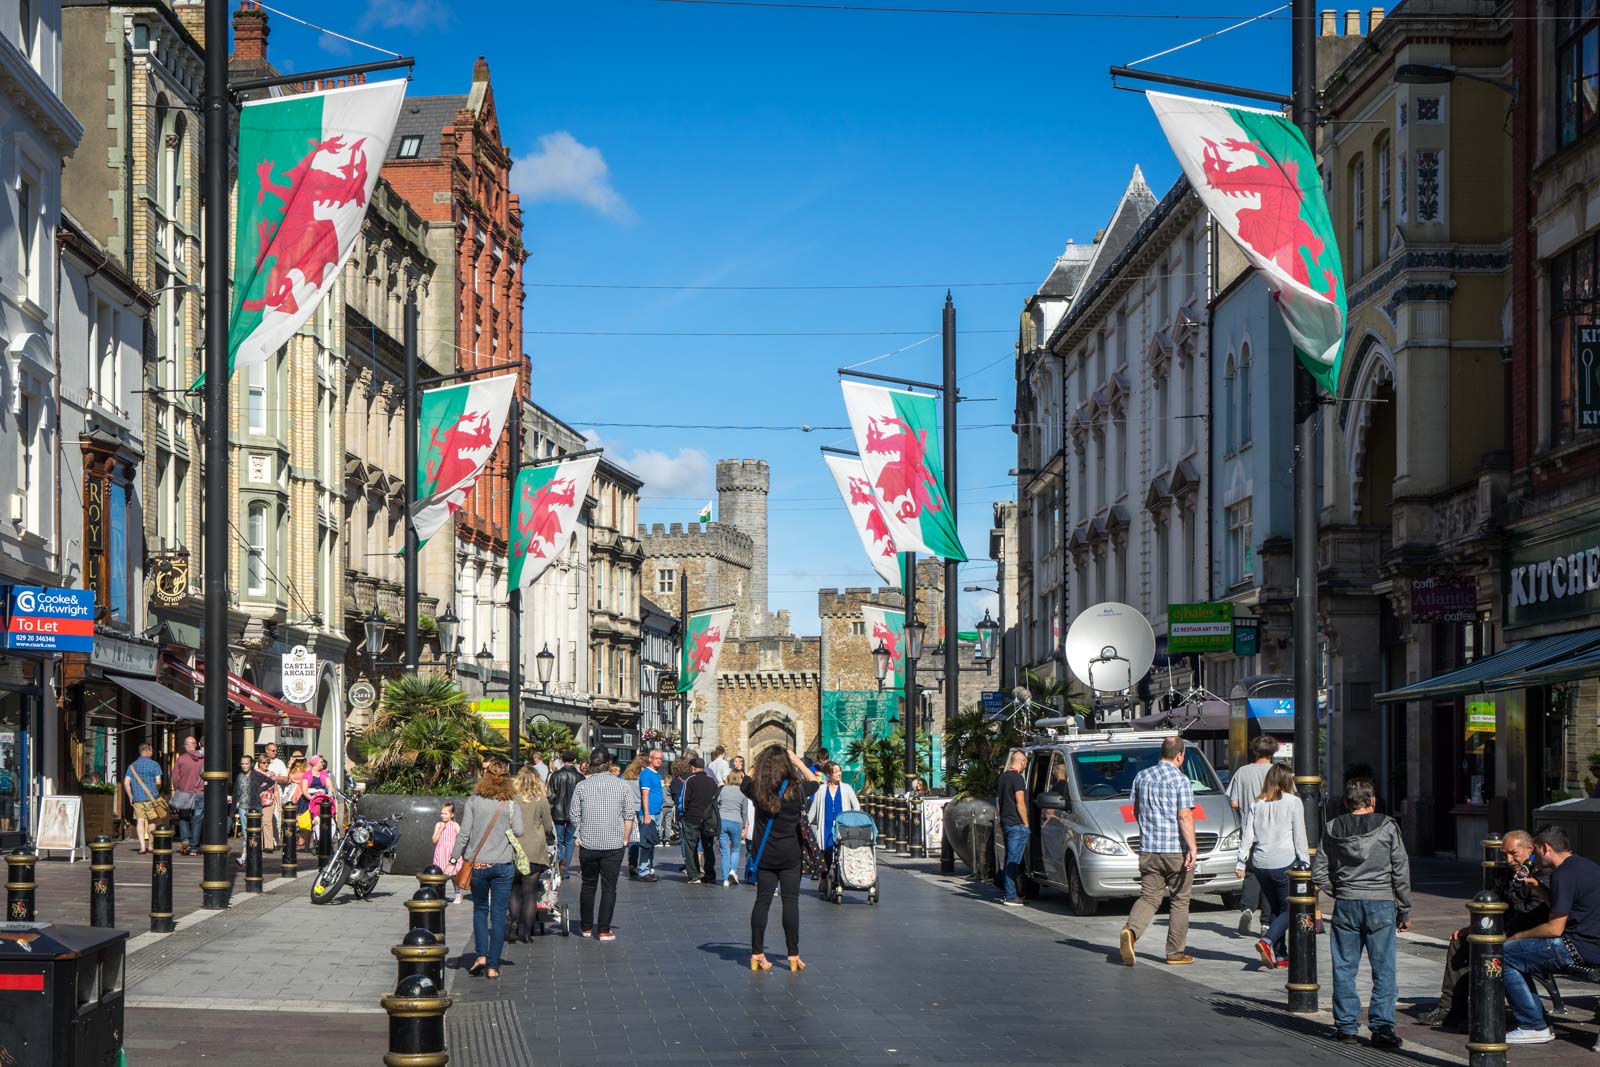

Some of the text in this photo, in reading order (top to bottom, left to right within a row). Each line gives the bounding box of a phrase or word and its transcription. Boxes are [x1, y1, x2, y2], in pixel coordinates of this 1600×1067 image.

[37, 593, 79, 605] Cooke&
[156, 592, 187, 603] CLOTHING
[1415, 591, 1475, 606] Atlantic
[37, 603, 88, 617] Arkwright
[1443, 611, 1476, 622] coffee
[16, 618, 58, 632] To Let
